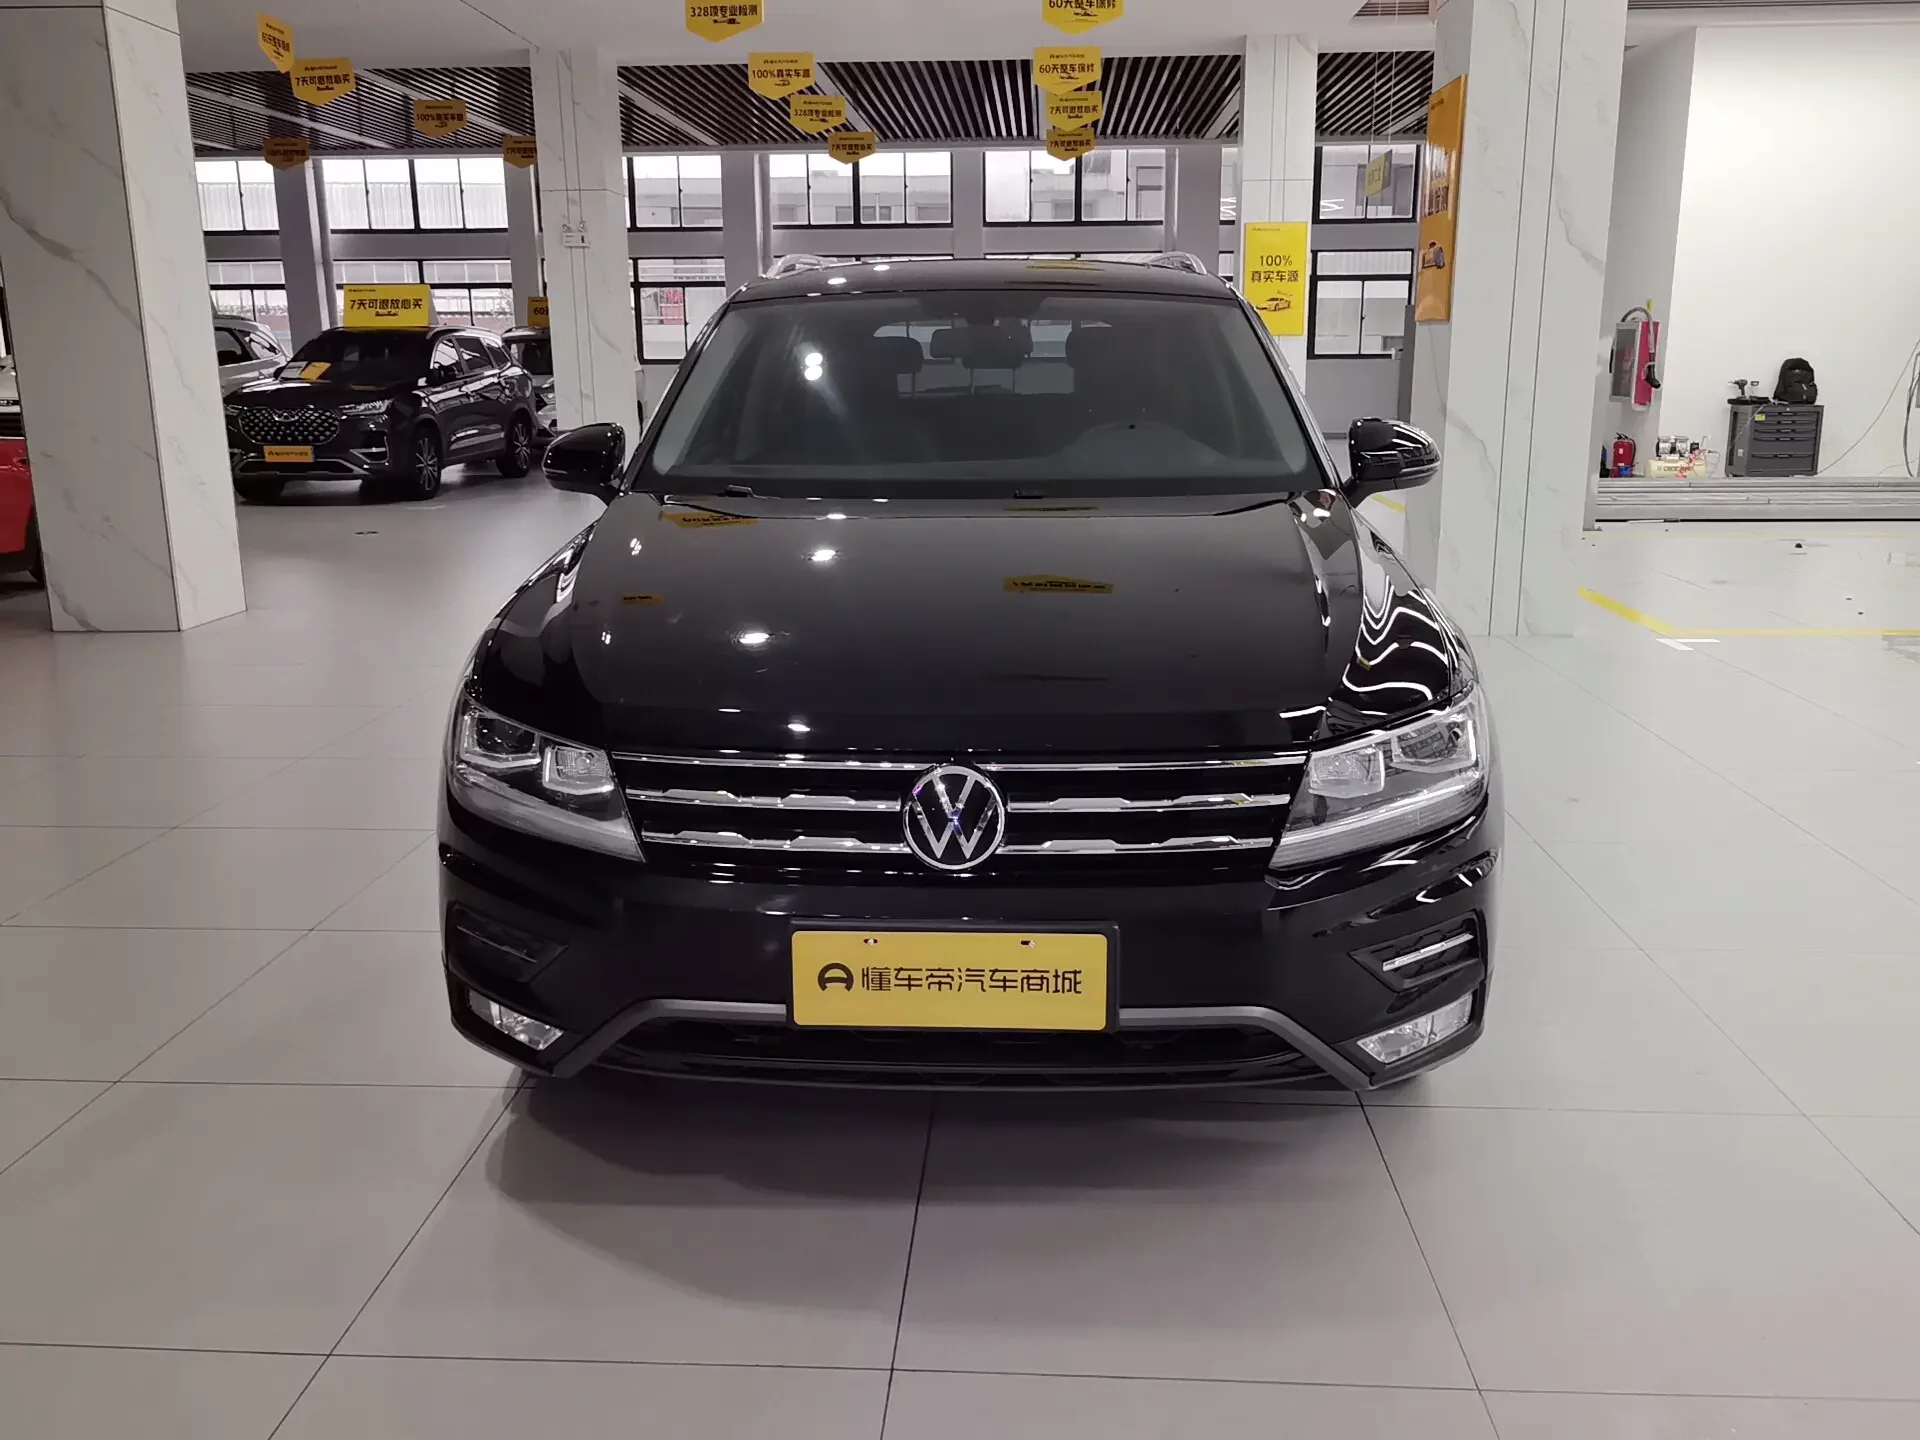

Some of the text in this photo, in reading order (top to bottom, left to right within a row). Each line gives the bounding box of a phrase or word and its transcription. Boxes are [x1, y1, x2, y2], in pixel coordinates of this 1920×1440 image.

[690, 4, 758, 18] 328项专业检测
[1039, 62, 1095, 74] 60天整车保修
[1260, 254, 1293, 267] 100%
[1251, 270, 1299, 283] 真实车源
[349, 298, 423, 310] 7天可退放心买
[861, 967, 1083, 995] 懂车帝汽车商城
